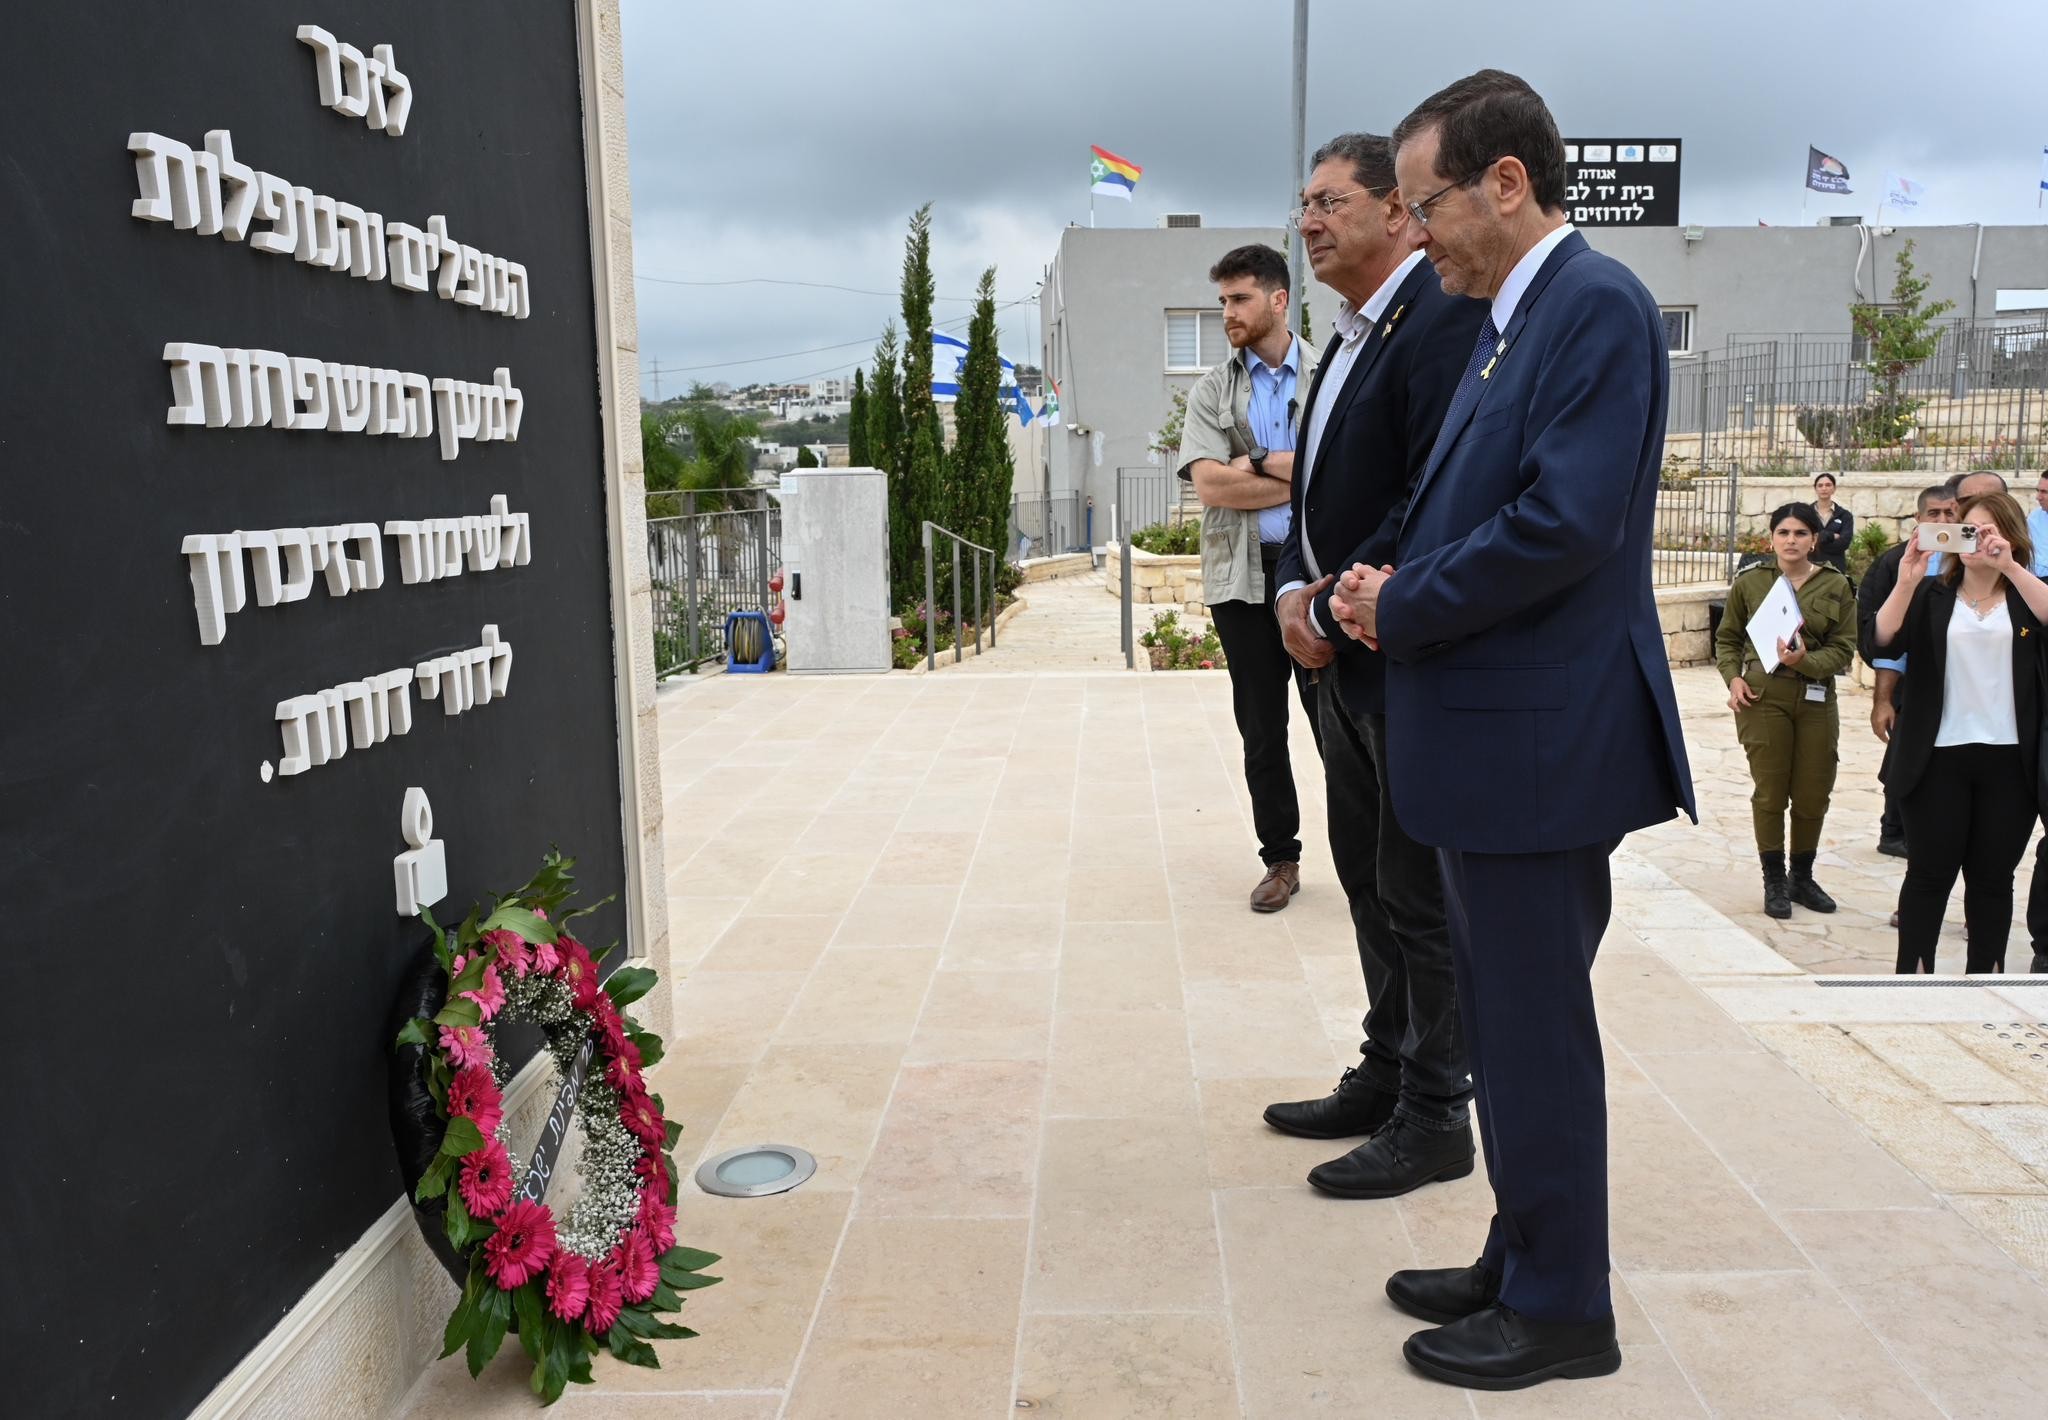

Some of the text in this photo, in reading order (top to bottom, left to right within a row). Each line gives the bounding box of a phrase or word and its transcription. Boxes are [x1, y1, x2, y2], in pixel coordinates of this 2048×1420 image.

[296, 25, 413, 137] לזכר
[1574, 202, 1645, 222] לדרוזים
[1577, 168, 1616, 180] אגודת
[1596, 185, 1615, 200] יד
[1620, 185, 1655, 200] בית
[127, 129, 531, 319] הנופלים והנופלות
[162, 342, 524, 460] למען המשפחות
[181, 494, 531, 645] ולשימור הזיכרון
[260, 624, 513, 783] לדורי דורות.
[519, 1145, 551, 1200] ישרא
